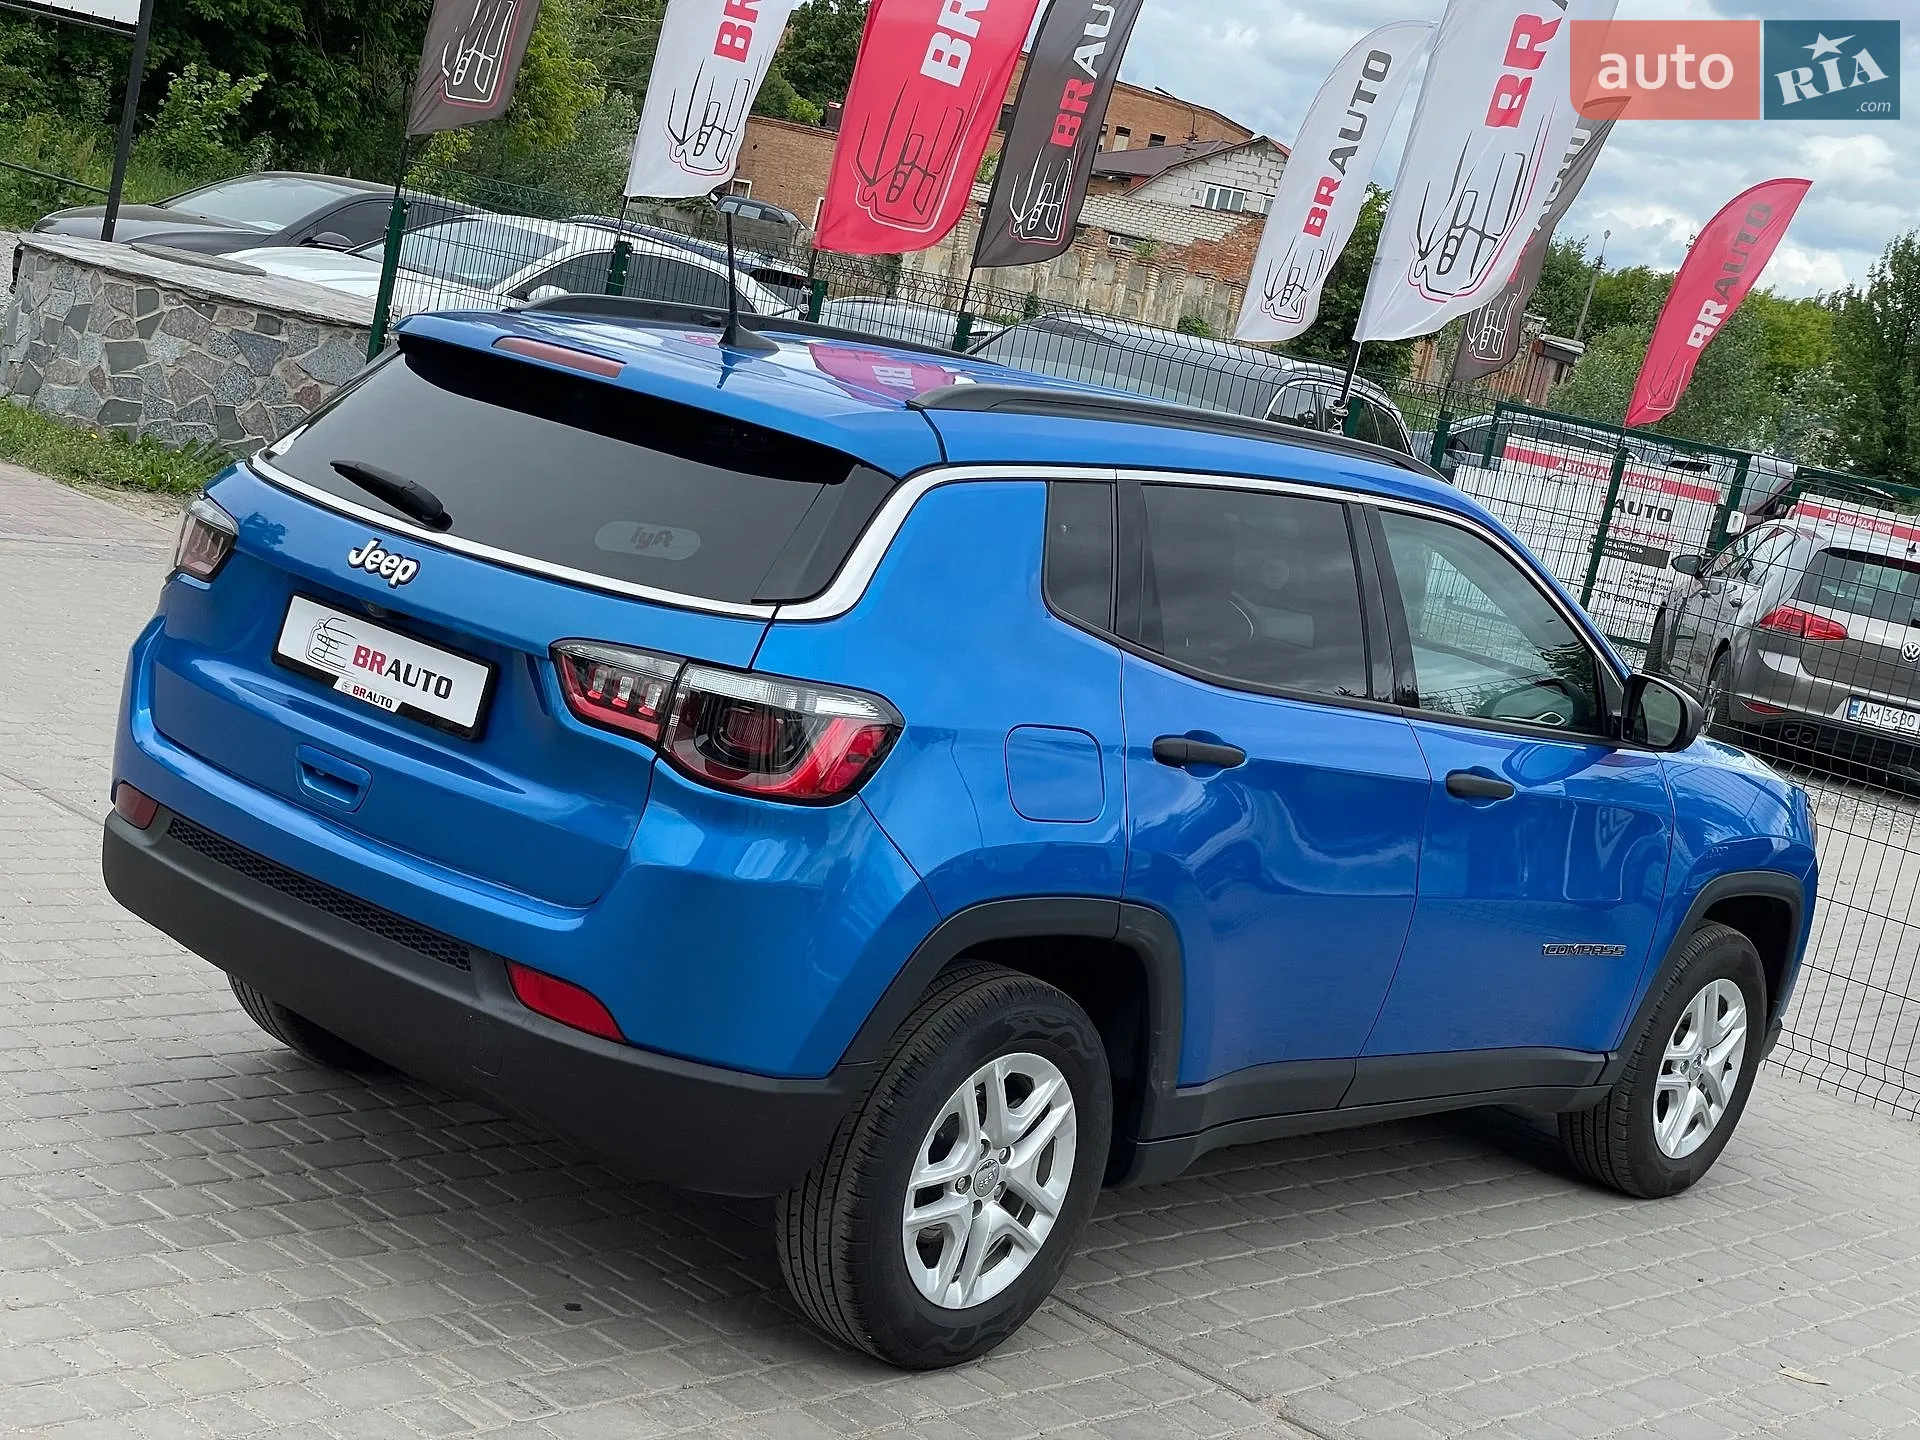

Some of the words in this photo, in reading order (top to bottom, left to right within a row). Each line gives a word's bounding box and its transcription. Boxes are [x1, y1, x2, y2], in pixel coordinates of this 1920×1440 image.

[919, 0, 990, 88] BR
[1050, 0, 1117, 147] BRAU
[1484, 0, 1569, 128] BR
[1302, 49, 1393, 238] BRAUTO
[1686, 202, 1773, 348] BRAUTO
[1555, 461, 1662, 490] АВТОМААНЧИК
[348, 537, 421, 588] Jeep
[352, 644, 454, 700] BRAUTO
[352, 685, 394, 709] BRAUTO
[1543, 943, 1628, 957] COMPASS
